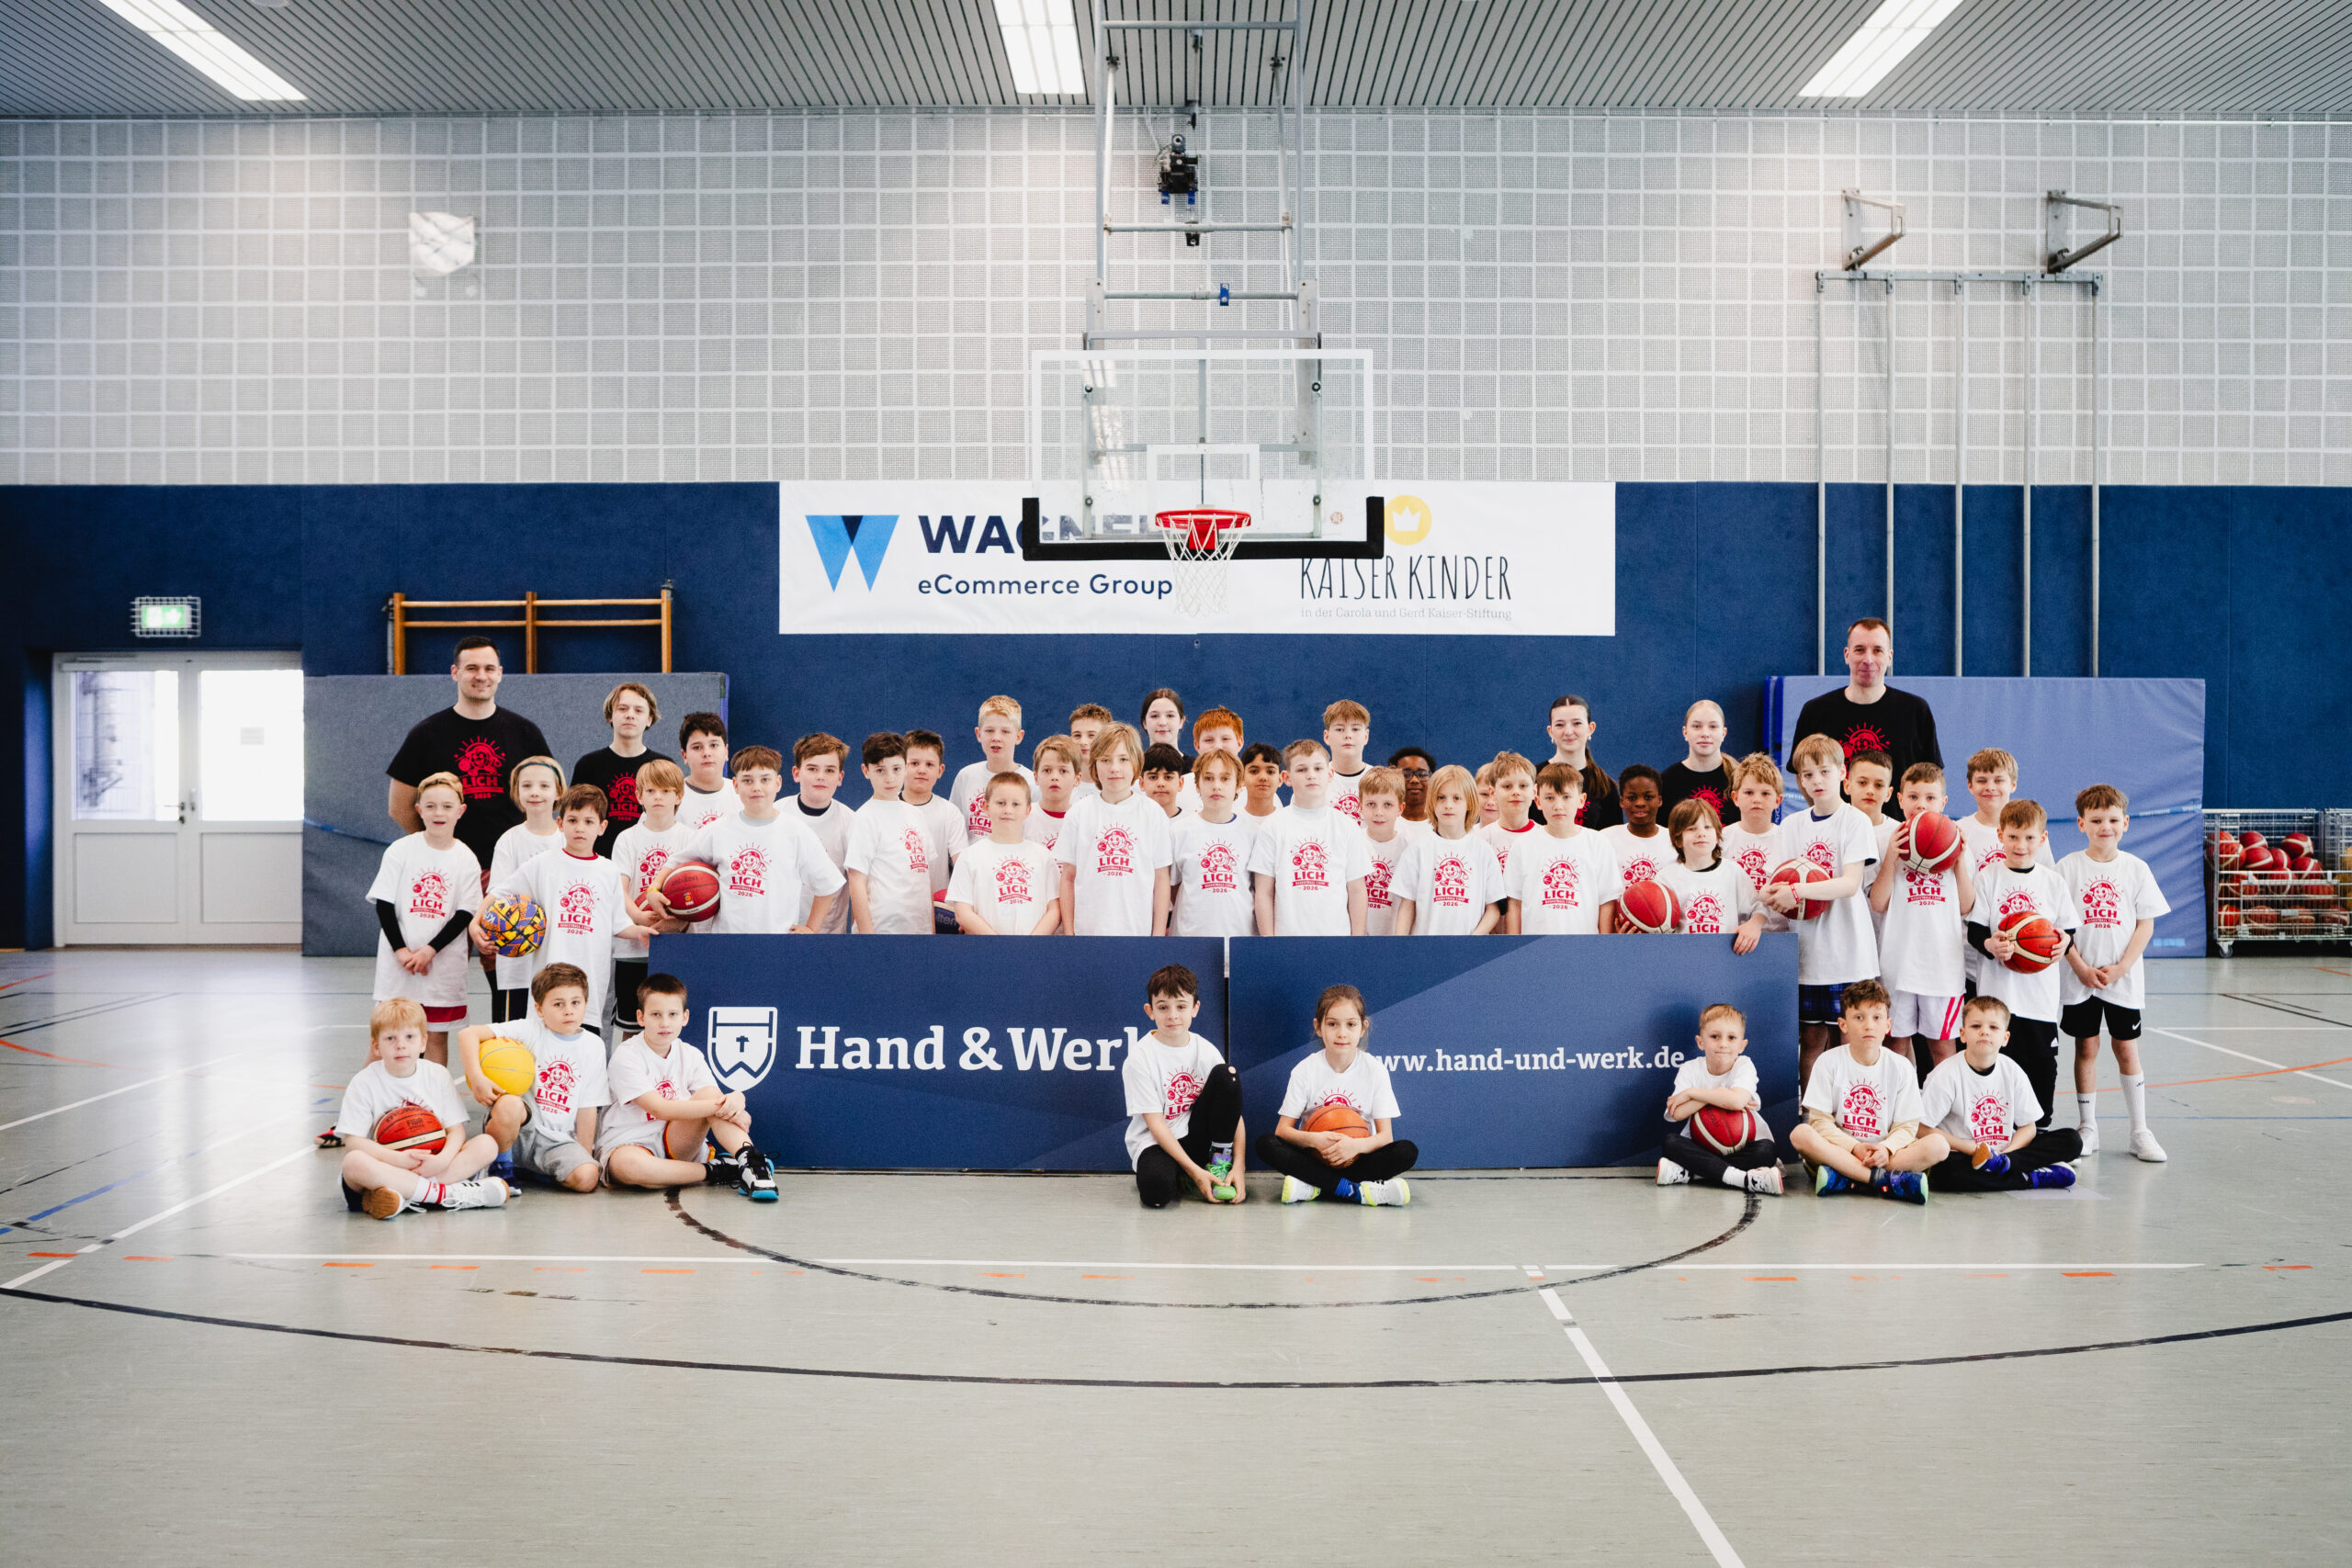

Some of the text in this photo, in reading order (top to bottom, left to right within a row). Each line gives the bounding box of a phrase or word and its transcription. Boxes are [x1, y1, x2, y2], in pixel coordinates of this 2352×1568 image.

[1301, 554, 1511, 600] KAISER KINDER
[918, 573, 1173, 600] eCommerce Group
[1301, 607, 1512, 621] in der Carola und Gerd Kaiser-Stiftung
[462, 776, 498, 788] LICH
[610, 803, 639, 812] LICH
[969, 818, 992, 828] LICH
[910, 854, 926, 863] LICH
[1099, 856, 1129, 866] LICH
[1203, 873, 1233, 883] LICH
[1294, 871, 1325, 880] LICH
[641, 877, 652, 886] LI
[731, 876, 762, 888] LICH
[999, 885, 1028, 896] LICH
[1366, 888, 1388, 899] ICH
[1434, 886, 1464, 897] LICH
[1544, 890, 1575, 899] LICH
[1909, 886, 1940, 896] LICH
[413, 898, 443, 909] LICH
[560, 913, 592, 925] LICH
[2086, 909, 2117, 919] LICH
[1689, 924, 1719, 933] LICH
[795, 1024, 945, 1070] Hand
[958, 1026, 1003, 1071] &
[537, 1089, 568, 1104] LICH
[1169, 1104, 1191, 1115] LIC
[1844, 1115, 1876, 1128] LICH
[1973, 1125, 2004, 1138] LICH
